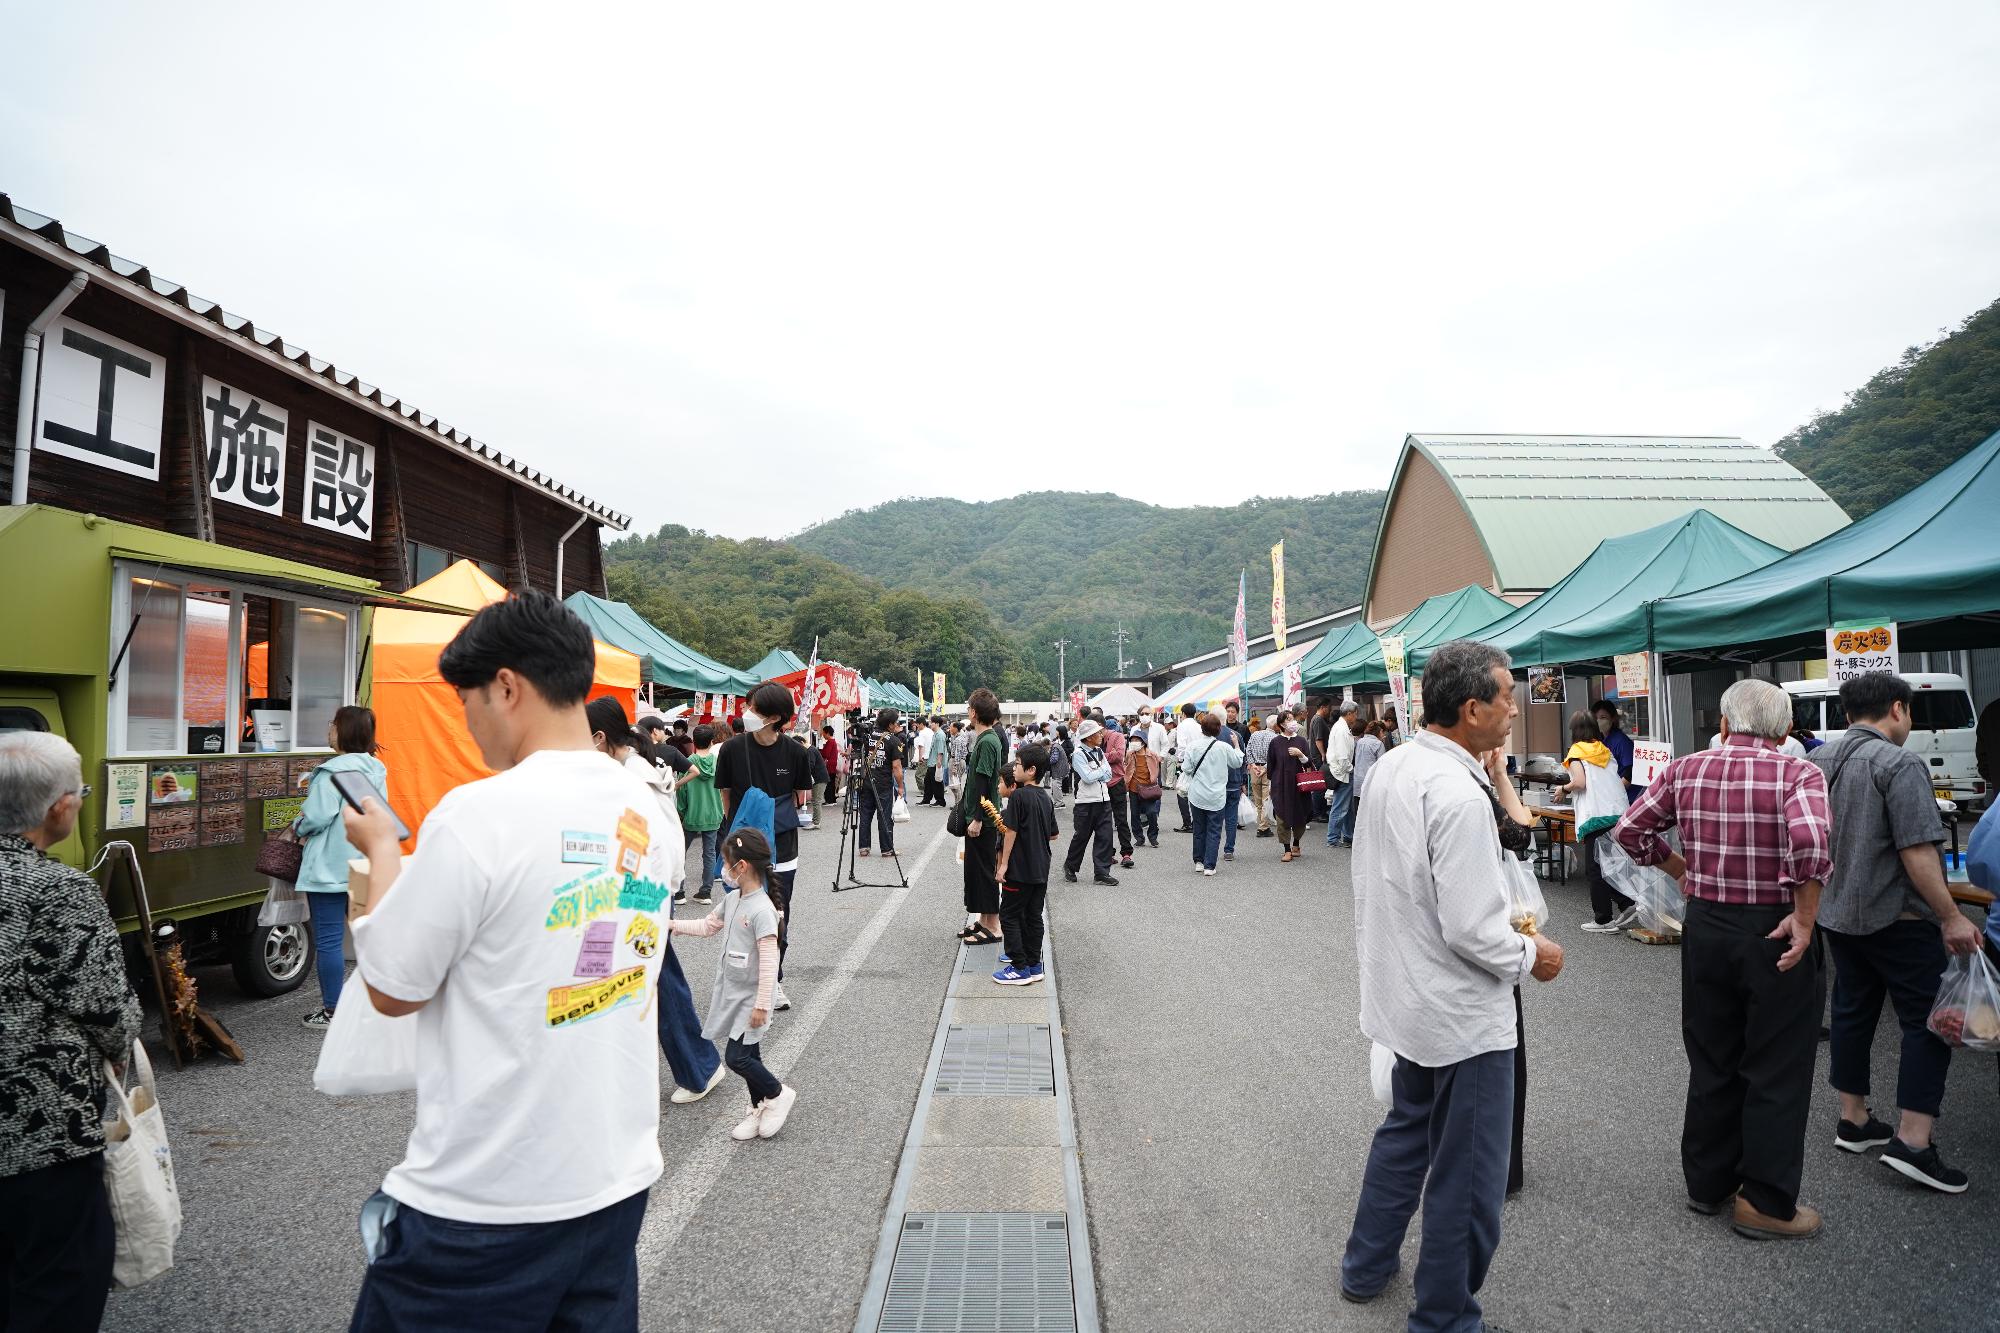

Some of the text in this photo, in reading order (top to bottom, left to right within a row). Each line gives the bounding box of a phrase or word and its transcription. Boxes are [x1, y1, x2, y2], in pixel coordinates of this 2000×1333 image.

[1837, 631, 1888, 650] 炭火焼
[1834, 656, 1893, 669] 牛・豚ミックス
[1635, 748, 1669, 763] 燃えるごみ
